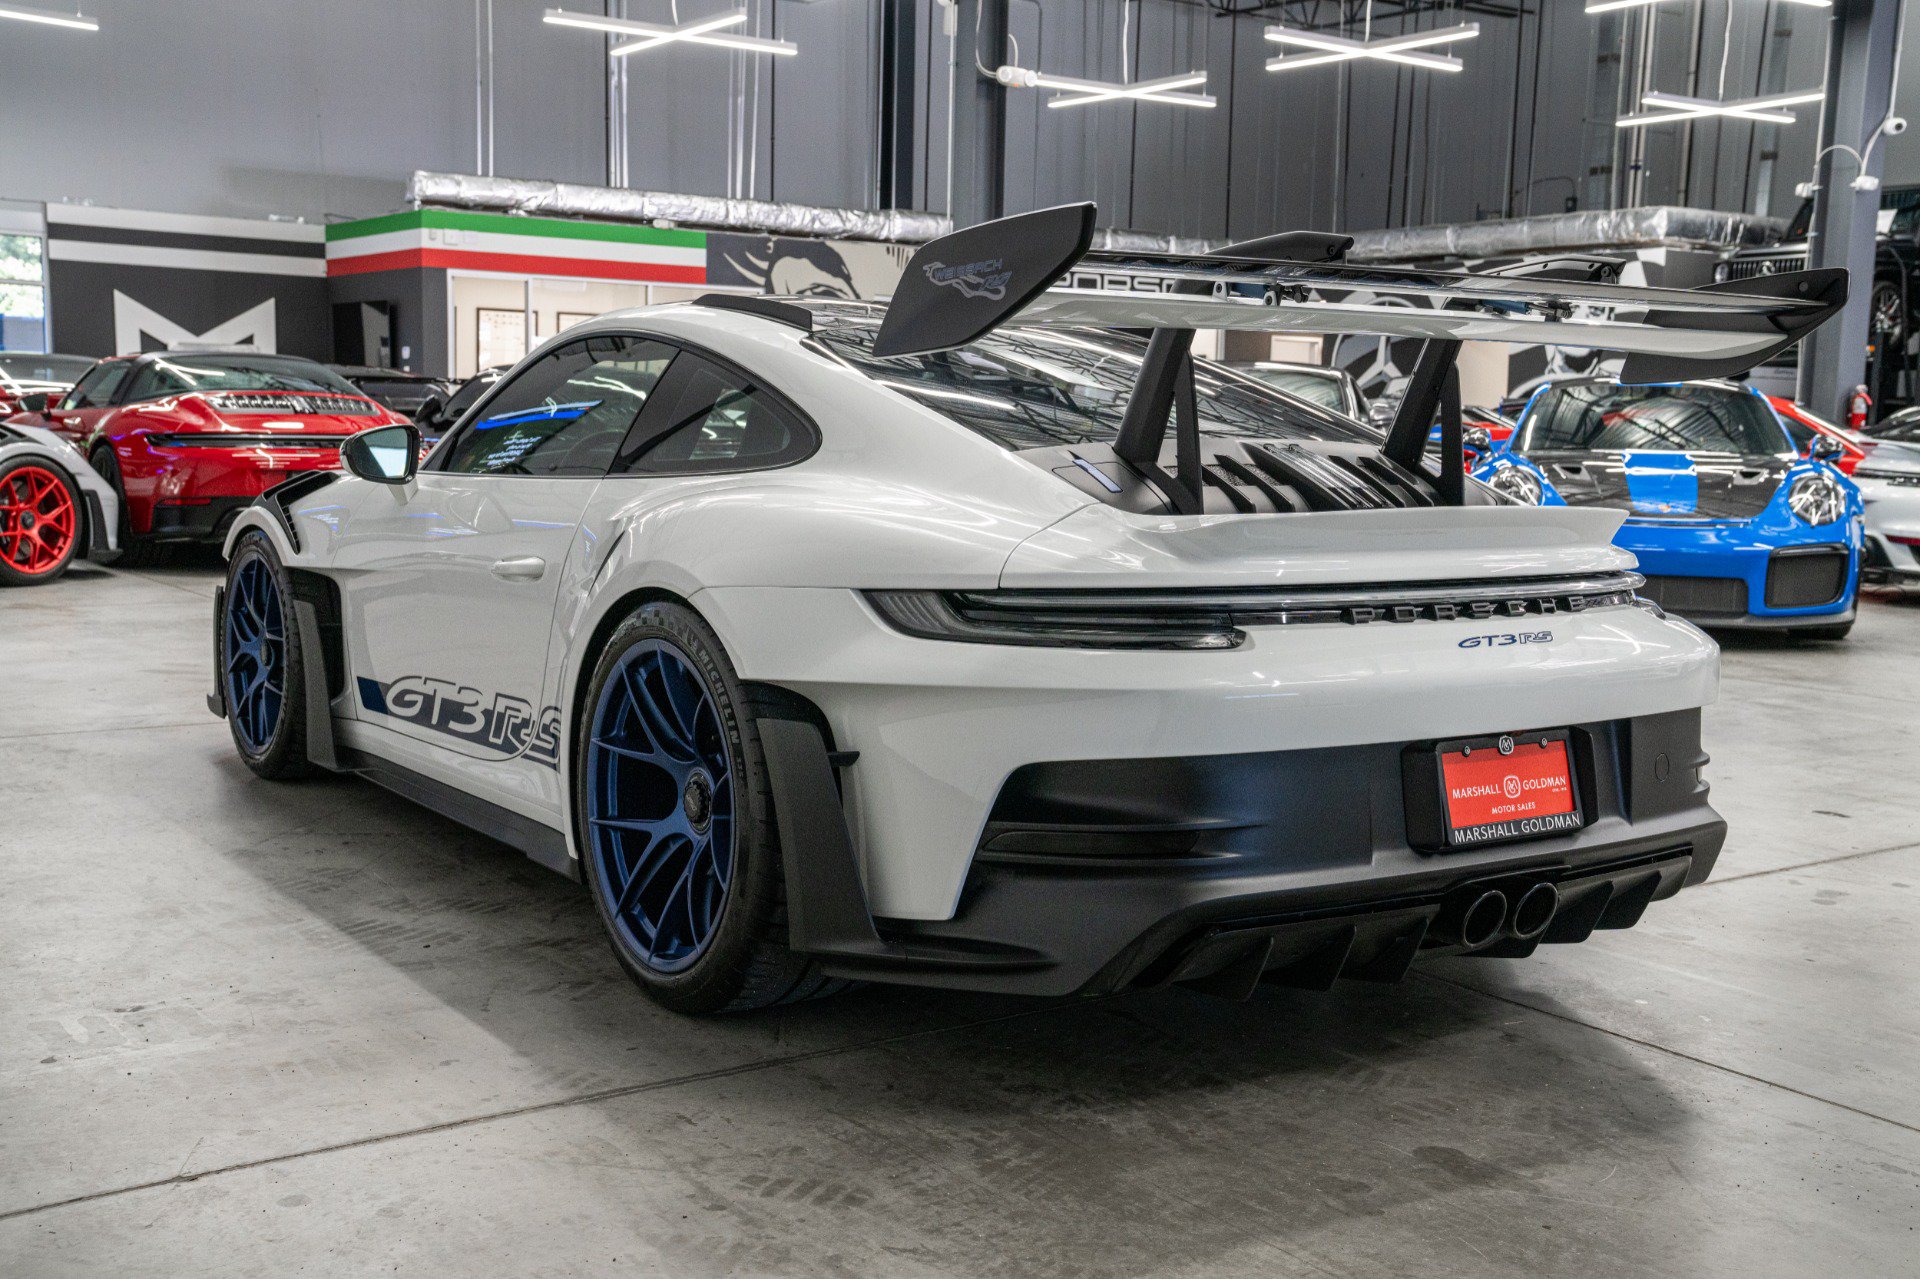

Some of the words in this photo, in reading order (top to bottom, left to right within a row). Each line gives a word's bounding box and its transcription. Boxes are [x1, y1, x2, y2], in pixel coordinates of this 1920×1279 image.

[1346, 595, 1584, 625] PORSCHE
[698, 647, 741, 744] MICHELIN
[1452, 784, 1502, 799] MARSHALL
[1522, 775, 1567, 790] GOLDMAN
[1491, 804, 1515, 814] MOTOR
[1517, 801, 1536, 810] SALES
[1454, 823, 1519, 844] MARSHALL
[1521, 813, 1581, 833] GOLDMAN
